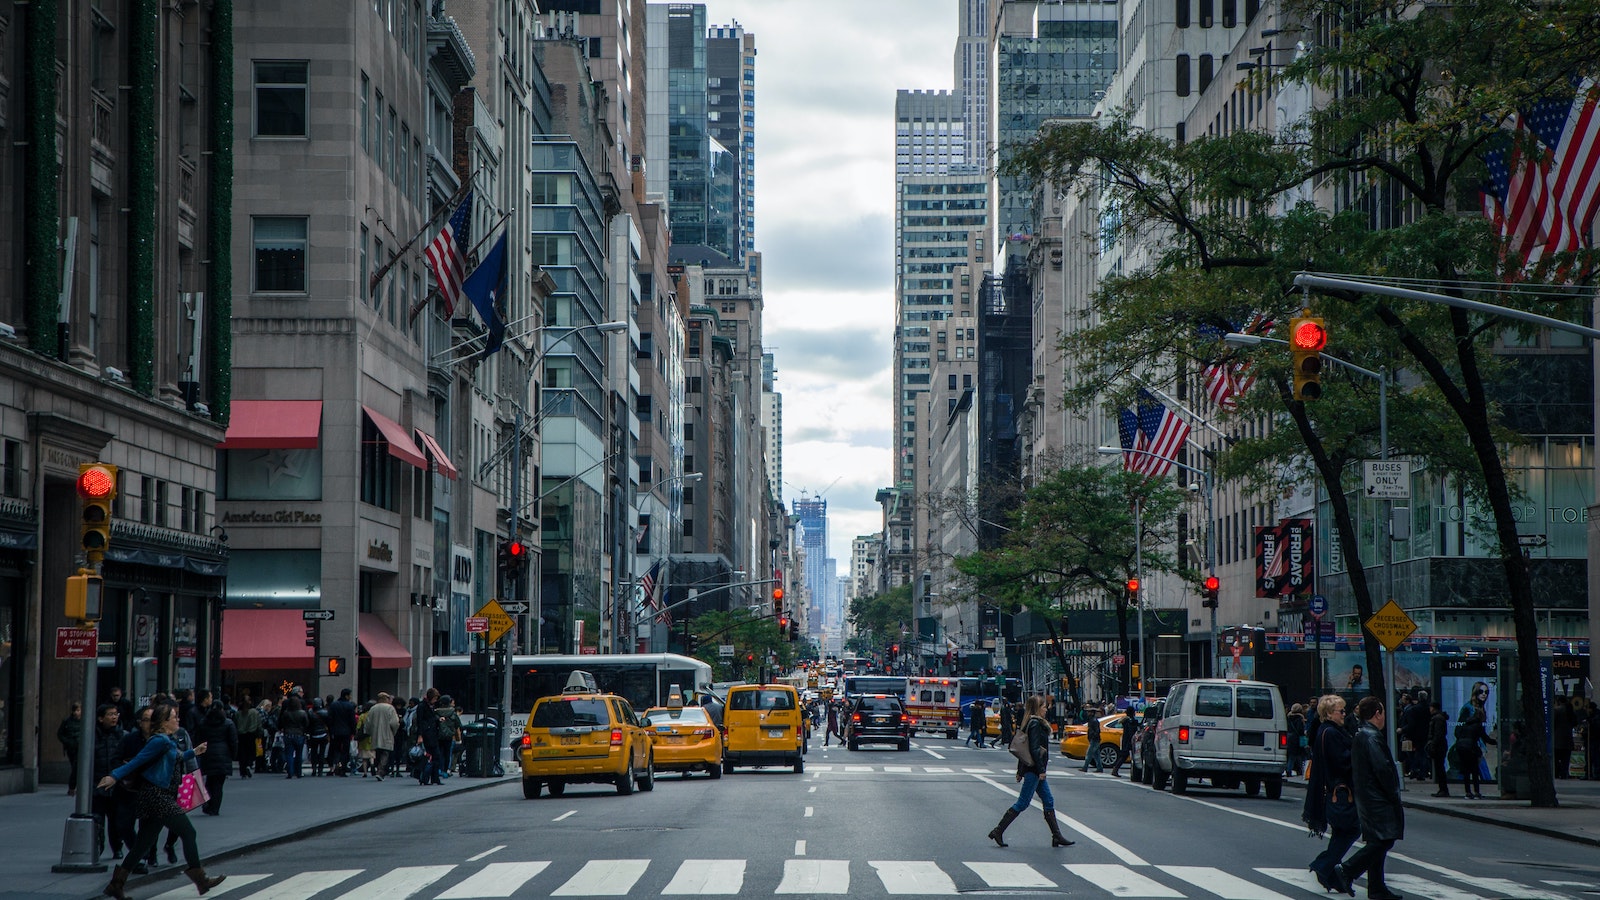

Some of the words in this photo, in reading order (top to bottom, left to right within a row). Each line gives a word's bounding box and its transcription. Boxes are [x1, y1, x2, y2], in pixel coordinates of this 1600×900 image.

[1372, 463, 1402, 472] BUSES
[1376, 476, 1399, 485] ONLY
[222, 510, 273, 523] American
[274, 510, 293, 523] Girl
[294, 510, 322, 523] Place
[1290, 533, 1303, 586] FRIDAYS
[1373, 622, 1411, 630] CROSSWALK
